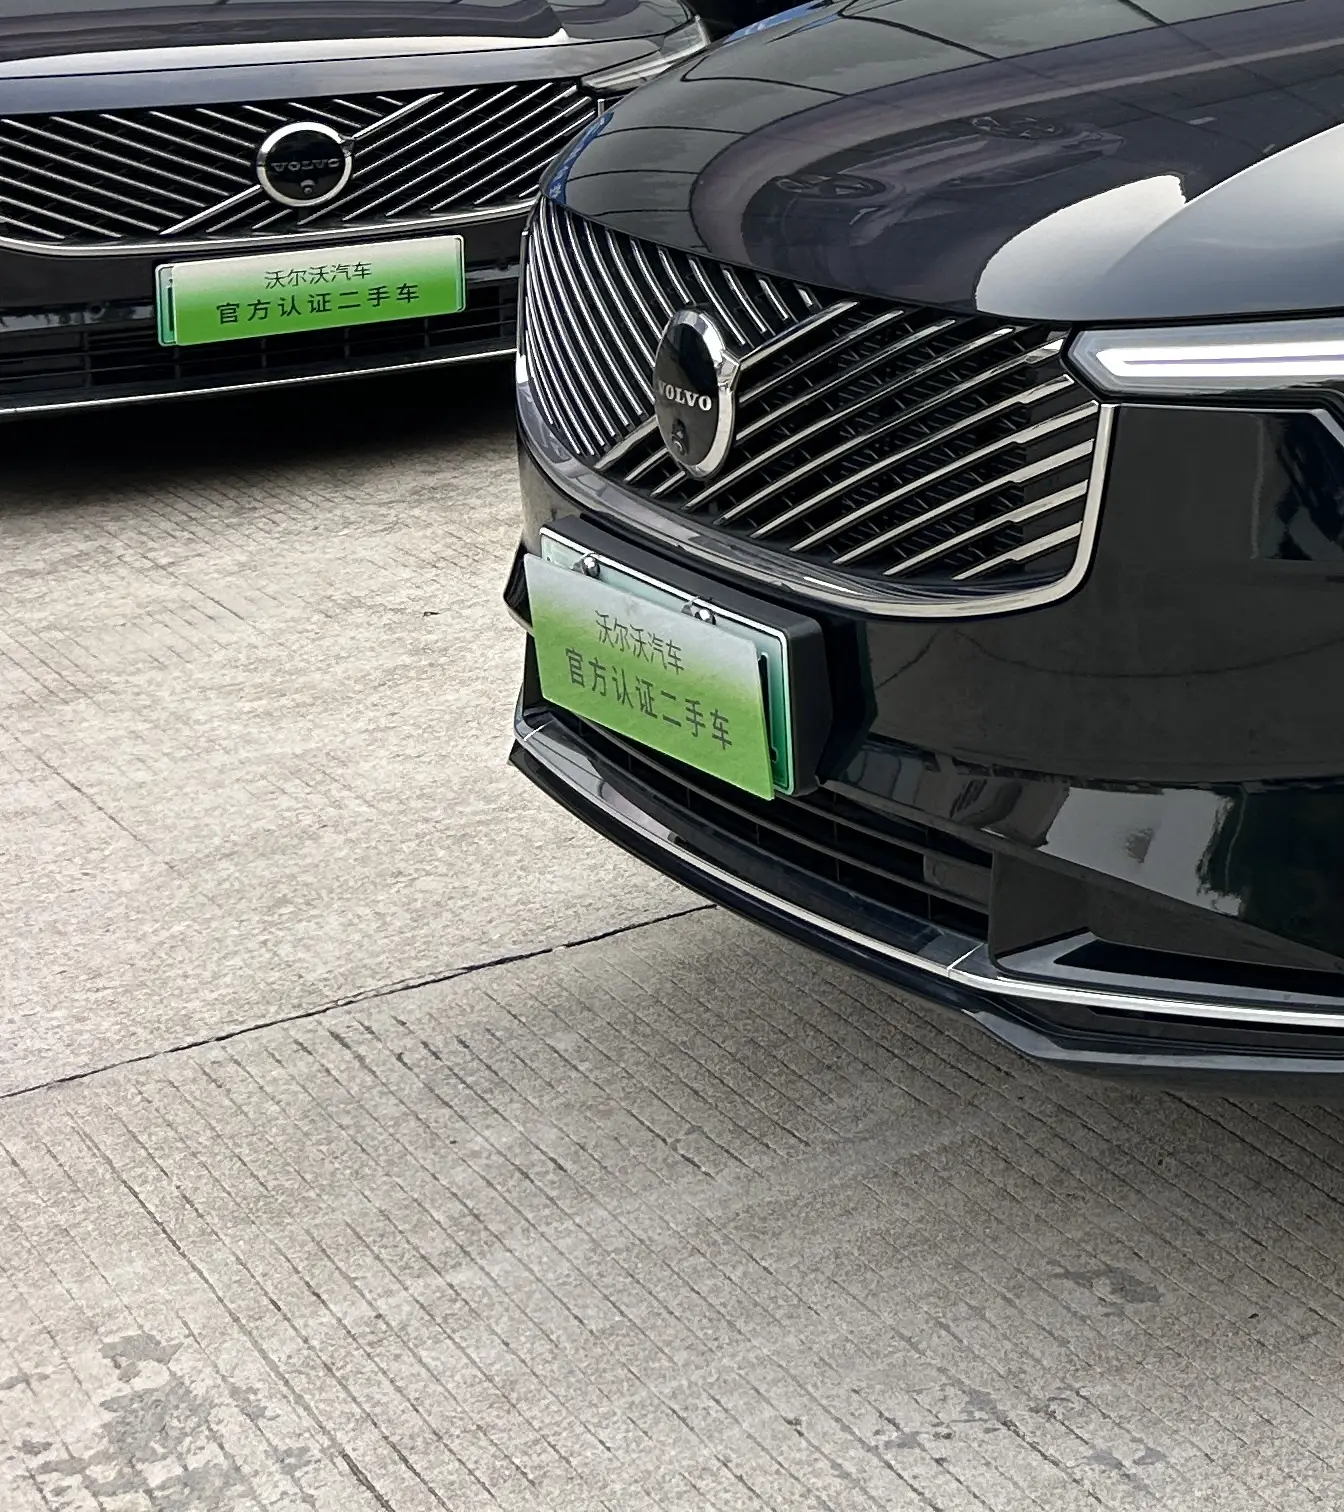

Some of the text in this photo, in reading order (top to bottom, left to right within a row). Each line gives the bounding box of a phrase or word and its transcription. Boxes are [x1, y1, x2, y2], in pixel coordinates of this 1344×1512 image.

[272, 158, 341, 173] VOLVO
[264, 261, 372, 290] 沃尔沃汽车
[216, 283, 420, 325] 官方认证二手车
[658, 379, 713, 412] VOLVO
[594, 609, 686, 676] 沃尔沃汽车
[565, 647, 733, 751] 官方认证二手车
